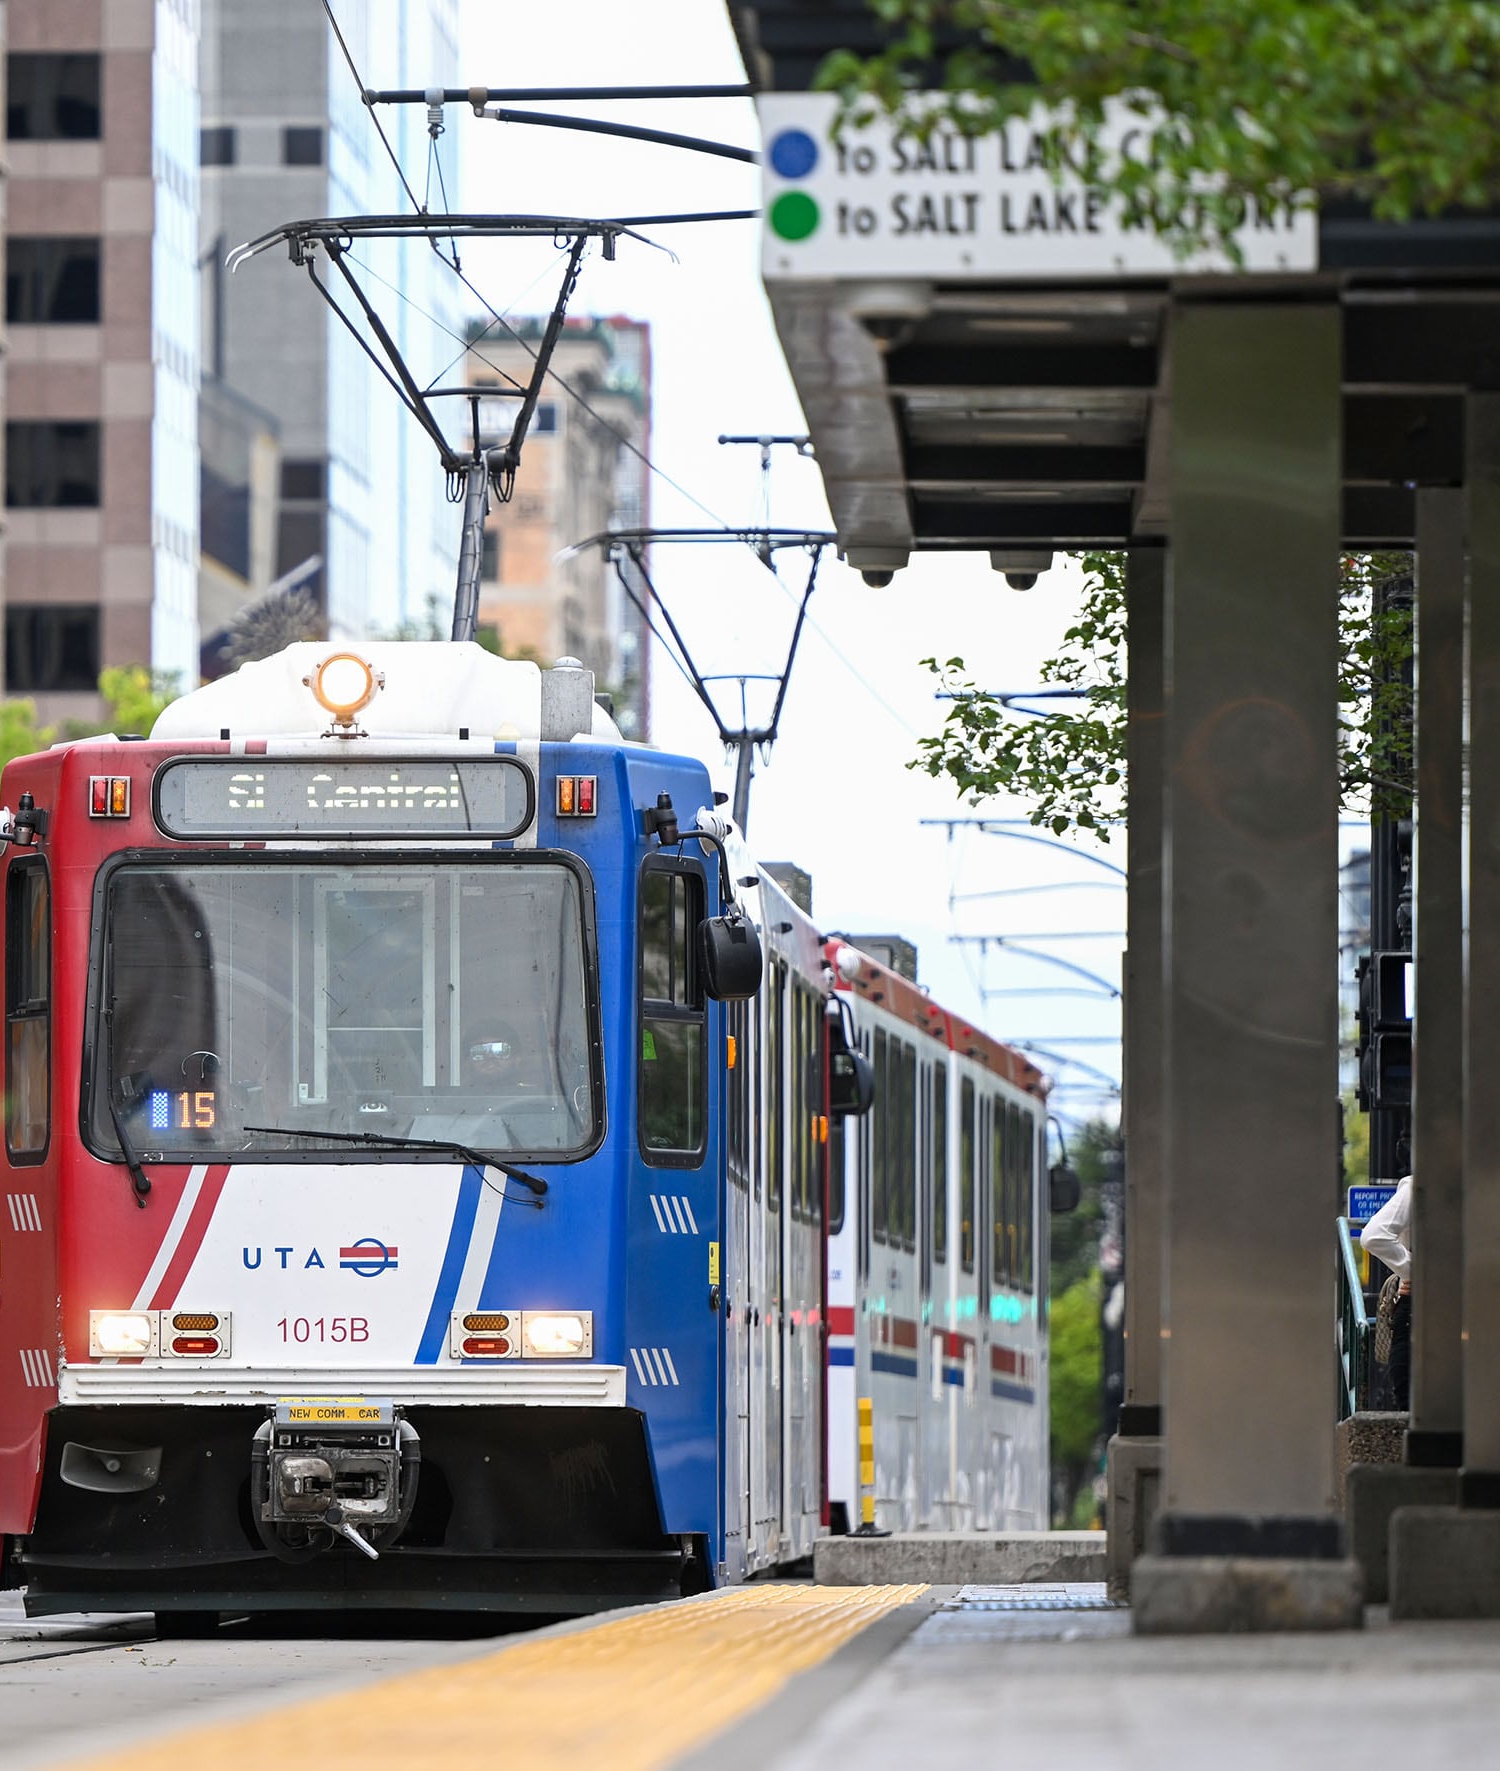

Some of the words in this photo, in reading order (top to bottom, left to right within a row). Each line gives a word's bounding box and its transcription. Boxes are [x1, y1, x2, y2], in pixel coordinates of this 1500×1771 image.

[836, 137, 877, 175] to
[837, 201, 877, 236] to
[891, 192, 979, 235] SALT
[1002, 192, 1101, 235] LAKE
[179, 1091, 215, 1128] 15
[243, 1247, 325, 1270] UTA
[277, 1317, 370, 1343] 1015B
[289, 1408, 311, 1418] NEW
[317, 1408, 351, 1418] COMM.
[358, 1408, 380, 1418] CAR
